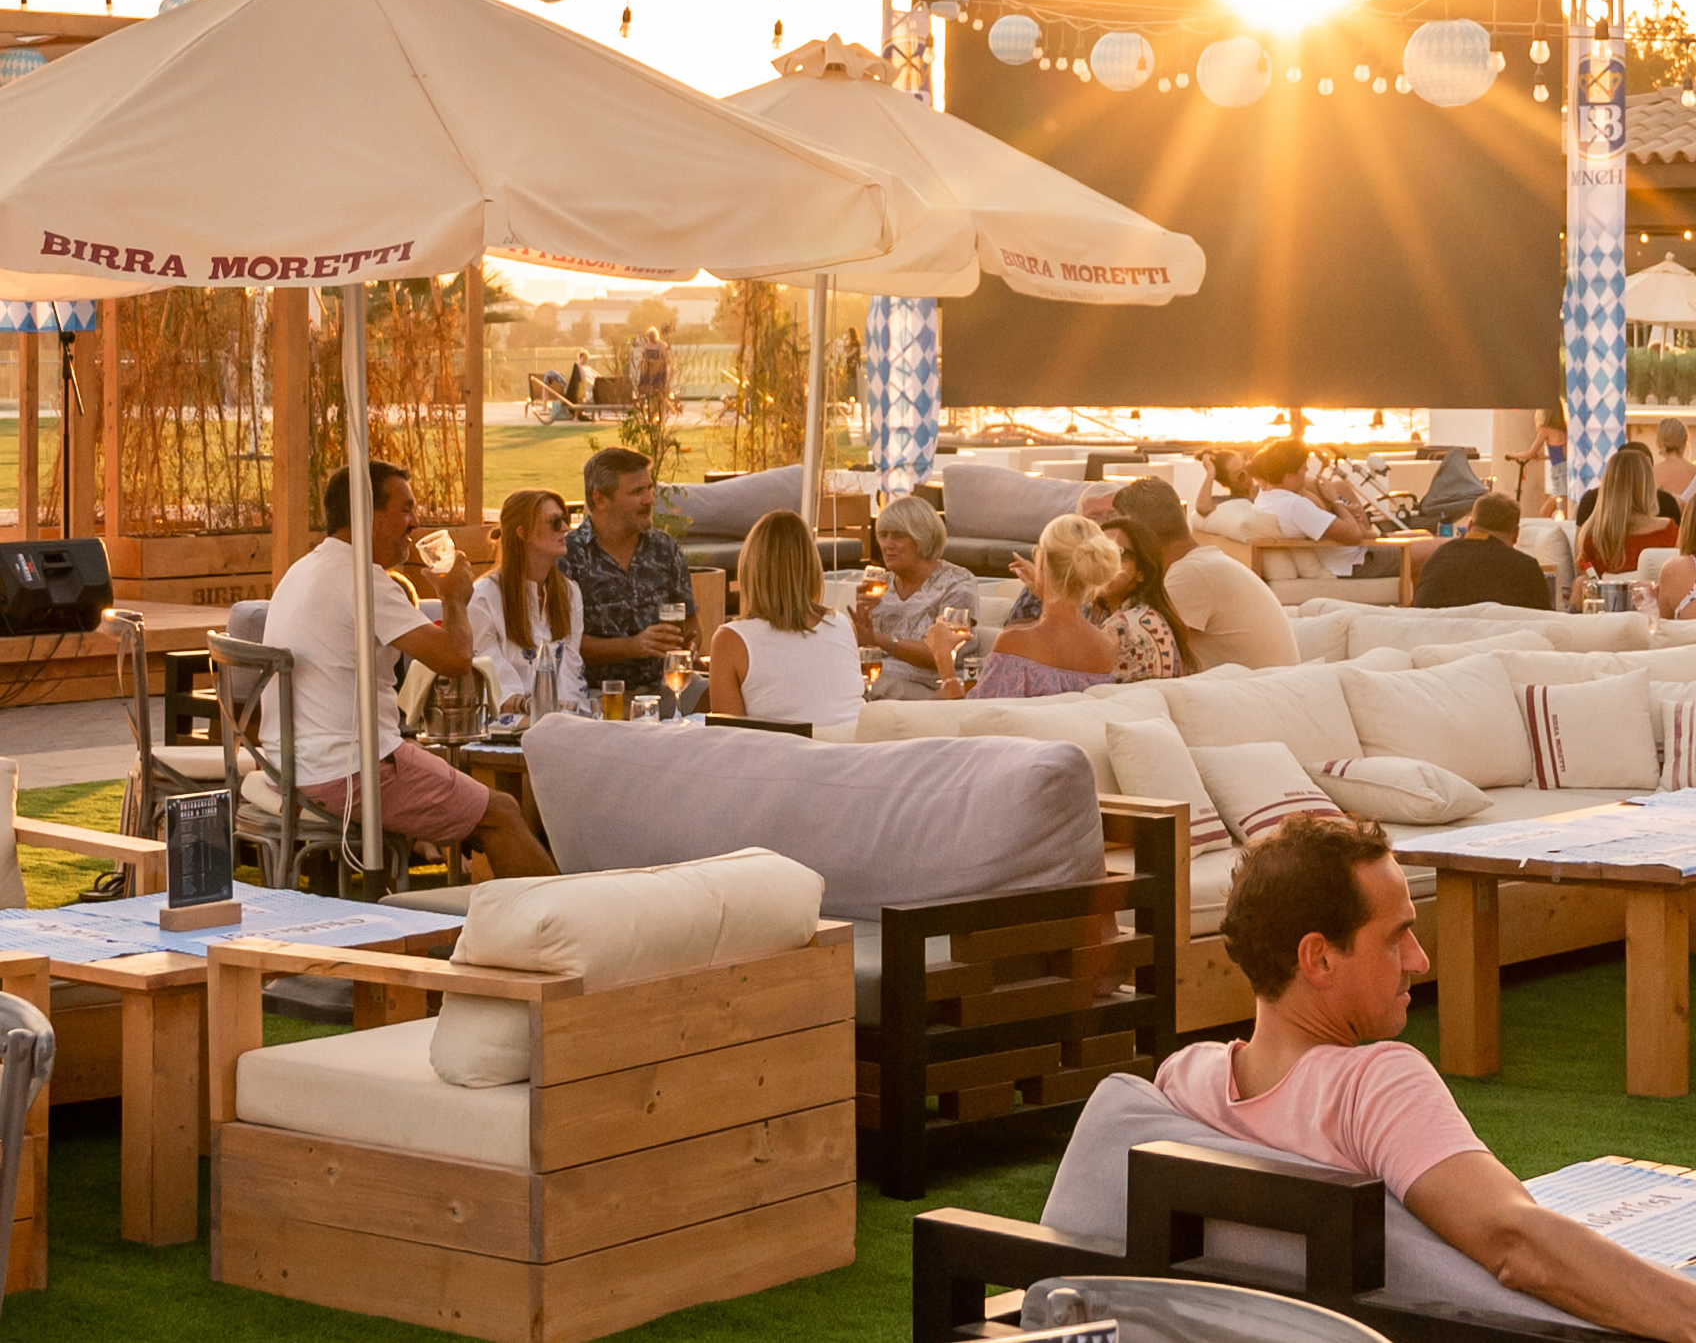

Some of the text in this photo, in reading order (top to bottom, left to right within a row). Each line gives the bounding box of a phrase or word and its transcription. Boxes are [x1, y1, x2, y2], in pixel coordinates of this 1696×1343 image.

[40, 231, 415, 280] BIRRA MORETTI
[1000, 248, 1171, 285] BIRRA MORETTI
